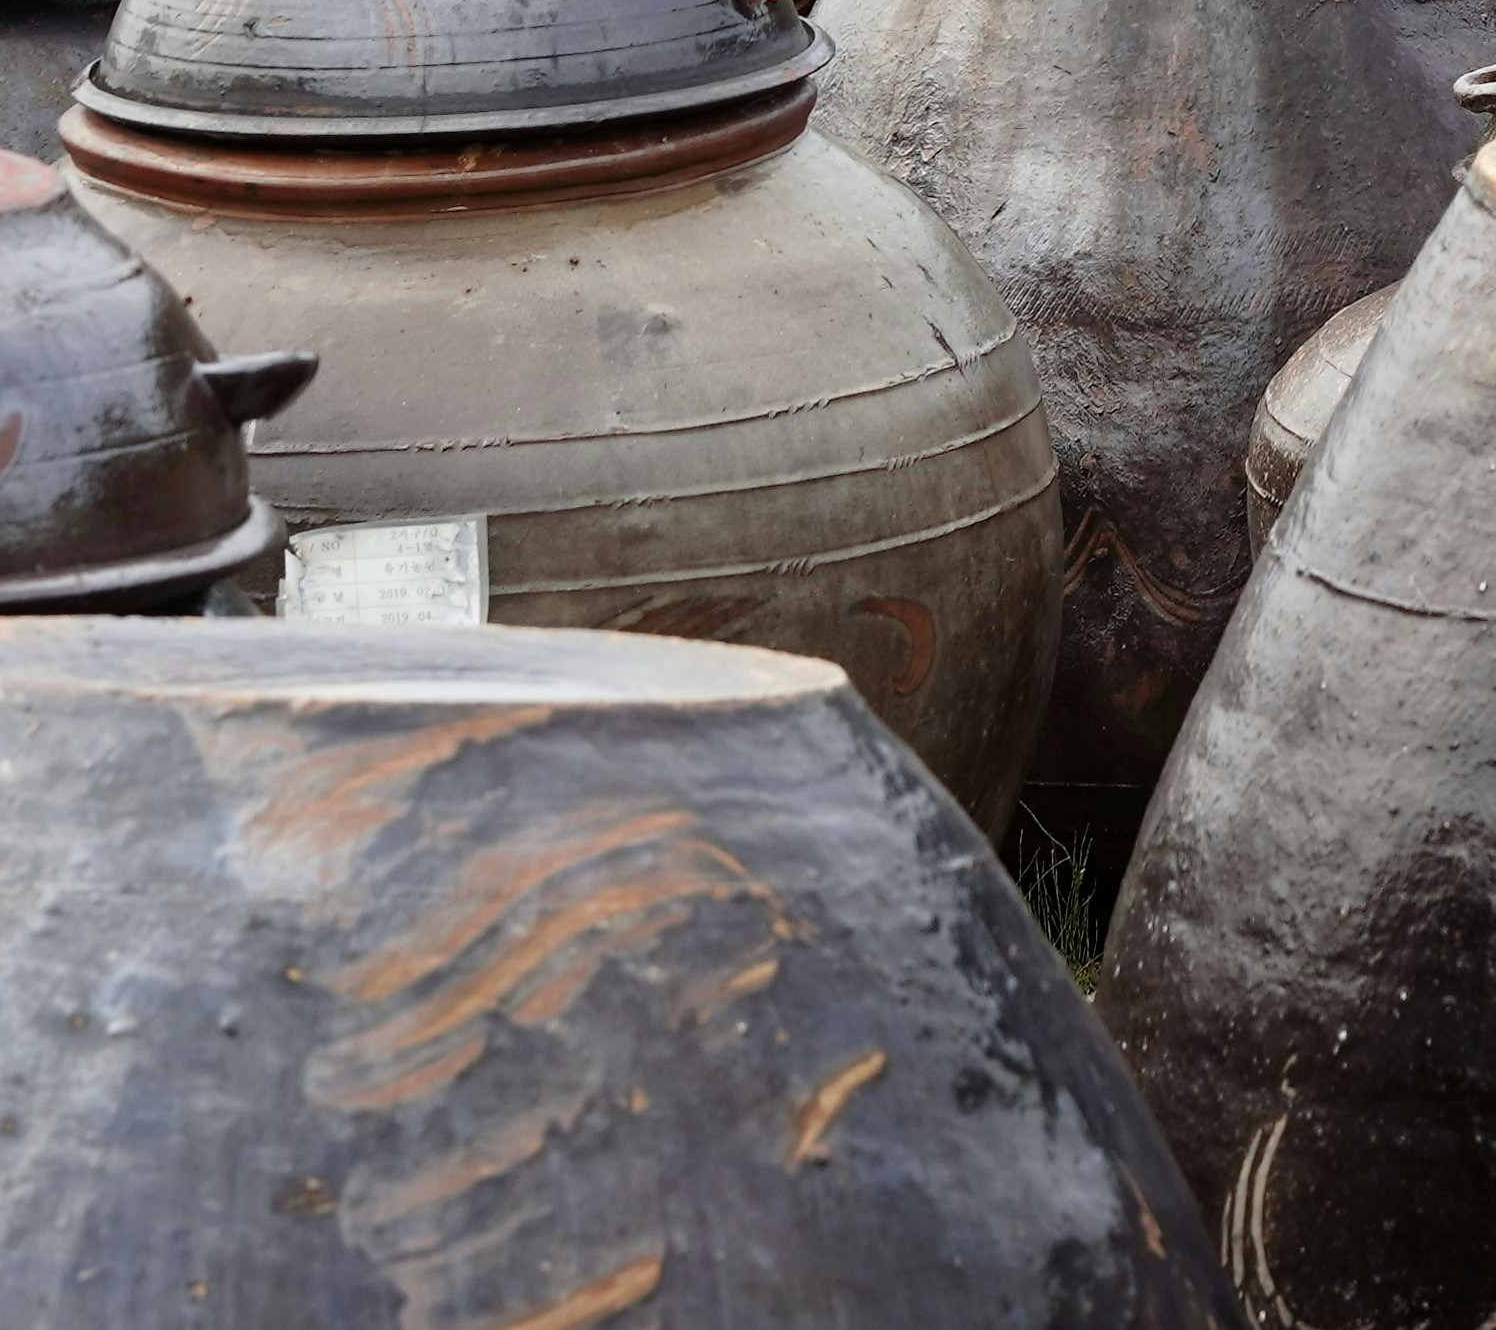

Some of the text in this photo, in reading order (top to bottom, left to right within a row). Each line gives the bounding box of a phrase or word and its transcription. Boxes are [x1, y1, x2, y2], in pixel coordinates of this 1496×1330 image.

[321, 540, 341, 552] NO
[379, 587, 411, 600] 2019.
[380, 611, 413, 625] 2019.
